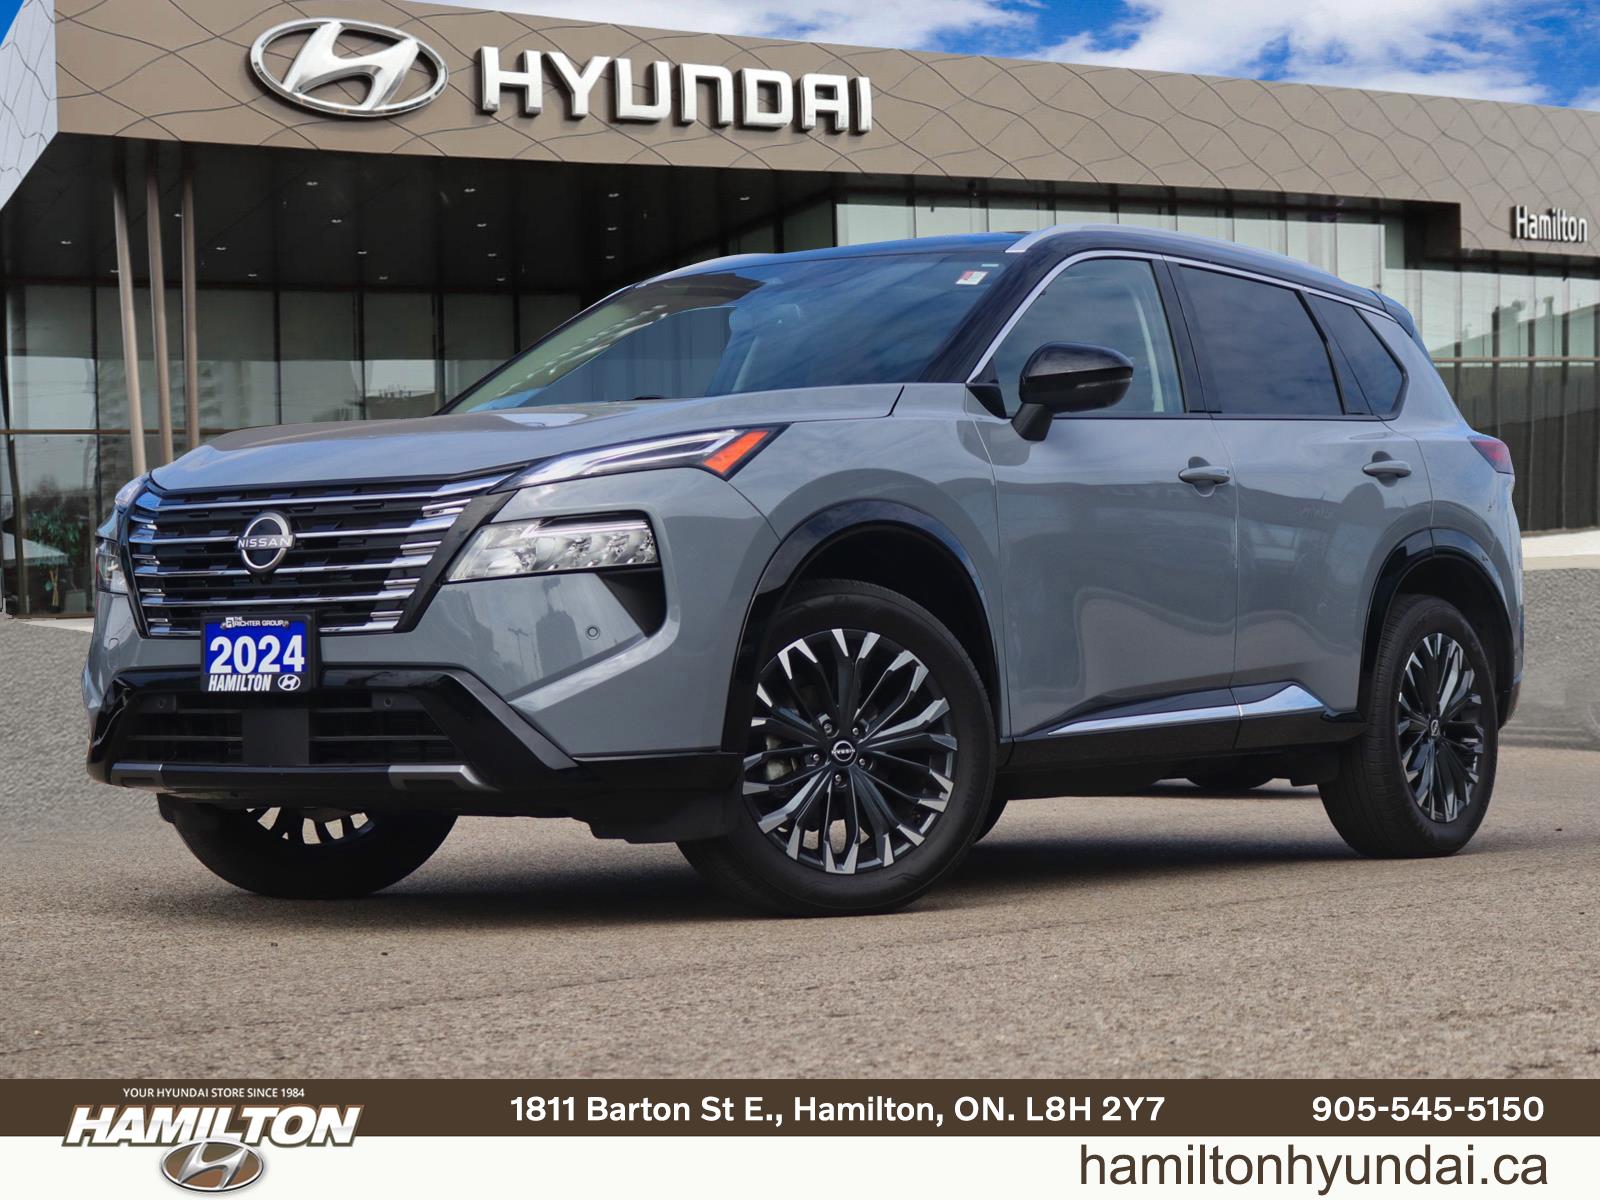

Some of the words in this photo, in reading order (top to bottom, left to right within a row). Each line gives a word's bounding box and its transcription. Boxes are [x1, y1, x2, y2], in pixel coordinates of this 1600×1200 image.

[480, 45, 874, 134] HYUNDAI
[1514, 204, 1588, 242] Hamilton
[238, 537, 290, 548] NISSAN
[261, 619, 284, 627] GROUP
[209, 634, 305, 674] 2024
[207, 674, 273, 692] HAMILTON
